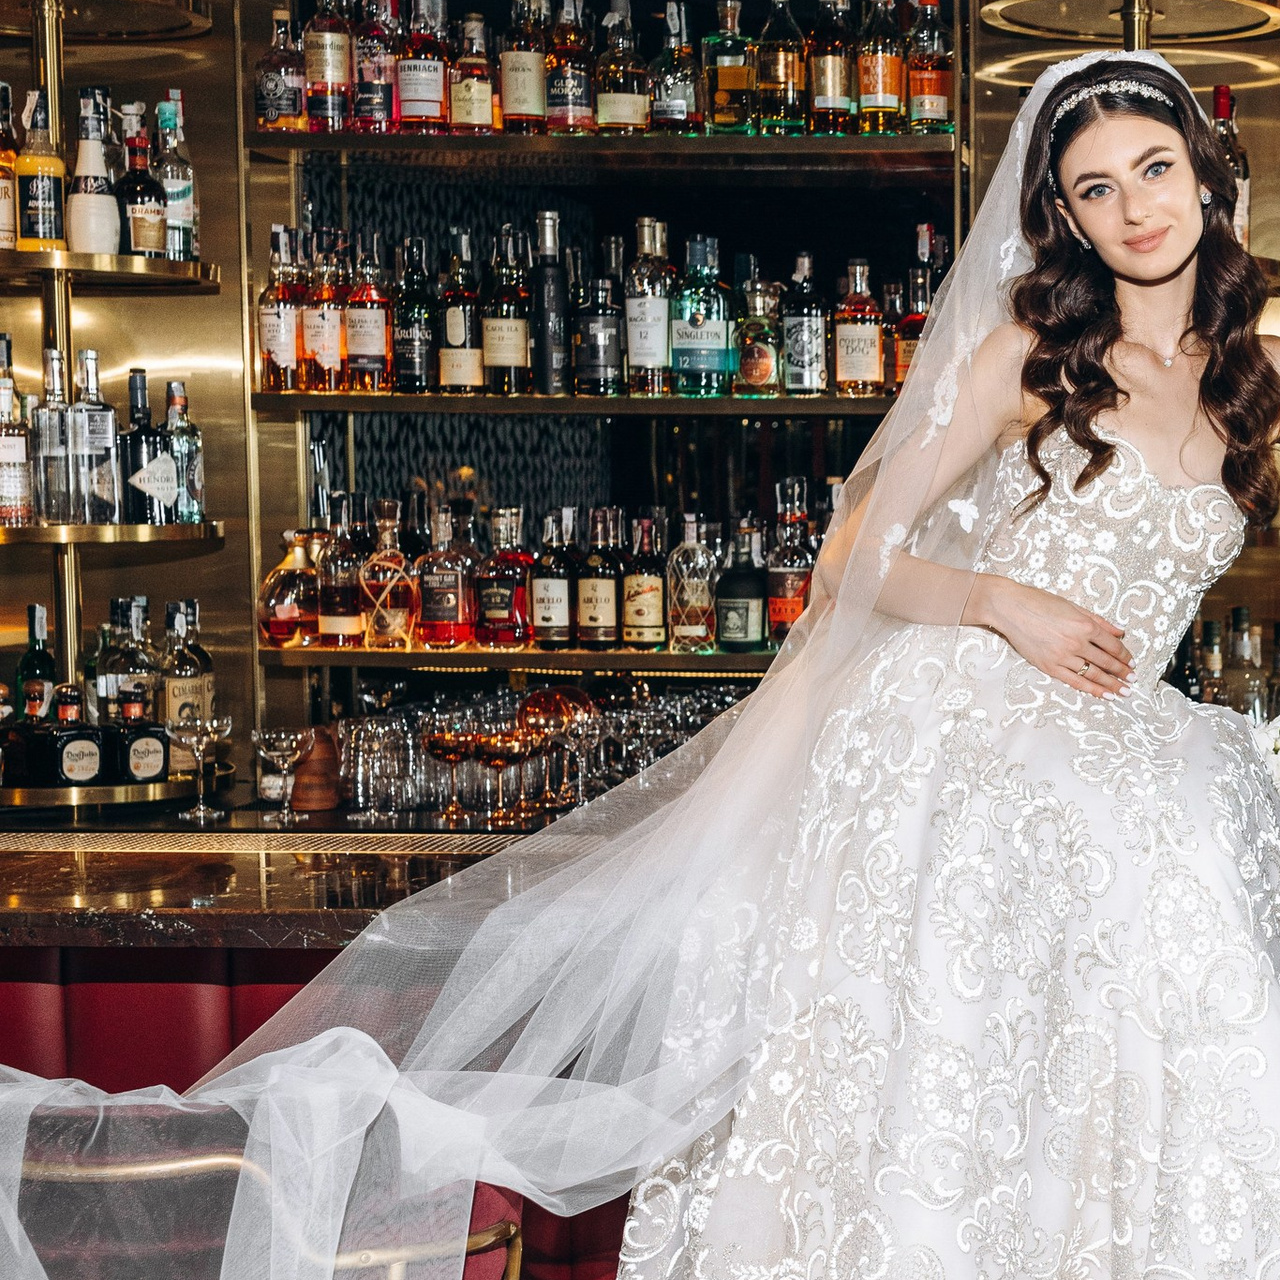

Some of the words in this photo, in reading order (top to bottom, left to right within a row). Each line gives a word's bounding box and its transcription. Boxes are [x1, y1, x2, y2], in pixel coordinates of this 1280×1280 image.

[550, 87, 583, 96] MORAY
[639, 330, 649, 340] 12
[676, 329, 721, 341] SINGLETON
[845, 346, 870, 355] DOG
[679, 356, 690, 368] 12
